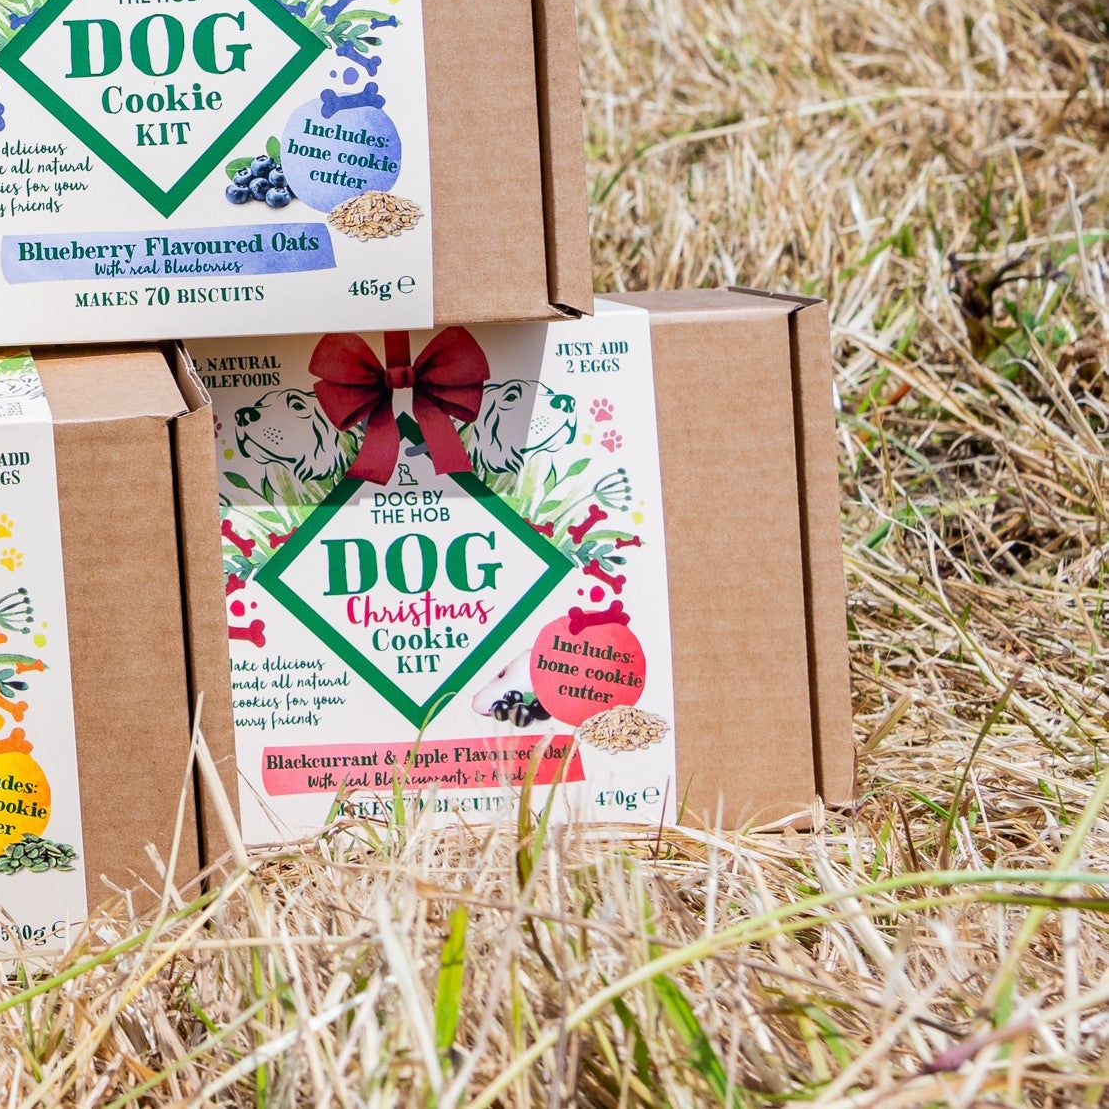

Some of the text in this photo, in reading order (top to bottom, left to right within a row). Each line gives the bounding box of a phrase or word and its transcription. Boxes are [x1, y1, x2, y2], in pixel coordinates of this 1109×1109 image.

[63, 11, 252, 79] DOG
[101, 83, 223, 115] Cookie
[136, 121, 191, 147] KIT
[303, 119, 389, 148] Includes:
[1, 139, 67, 157] delicious
[287, 139, 397, 174] bone cookie
[11, 158, 33, 174] all
[37, 156, 93, 175] natural
[26, 177, 50, 197] for
[54, 181, 89, 196] your
[309, 169, 367, 190] cutter
[11, 197, 63, 217] friends
[17, 233, 319, 263] Blueberry Flavoured Oats
[95, 258, 243, 277] With real Blueberries
[75, 285, 265, 308] MAKES 70 BISCUITS
[347, 278, 391, 301] 465g
[555, 341, 629, 357] JUST ADD
[207, 356, 281, 371] NATURAL
[566, 358, 620, 373] 2 EGGS
[374, 490, 443, 507] DOG BY
[371, 507, 451, 524] THE HOB
[321, 531, 503, 596] DOG
[347, 588, 495, 629] Christmas
[372, 627, 469, 651] Cookie
[551, 635, 635, 665] Includes:
[263, 655, 325, 673] delicious
[397, 654, 440, 674] KIT
[537, 655, 643, 689] bone cookie
[271, 673, 293, 689] all
[297, 671, 351, 689] natural
[232, 693, 347, 711] cookies for your
[557, 682, 613, 705] cutter
[234, 711, 322, 730] urry friends
[266, 749, 379, 770] Blackcurrant
[384, 751, 397, 765] &
[307, 774, 338, 789] With
[594, 789, 637, 810] 470g
